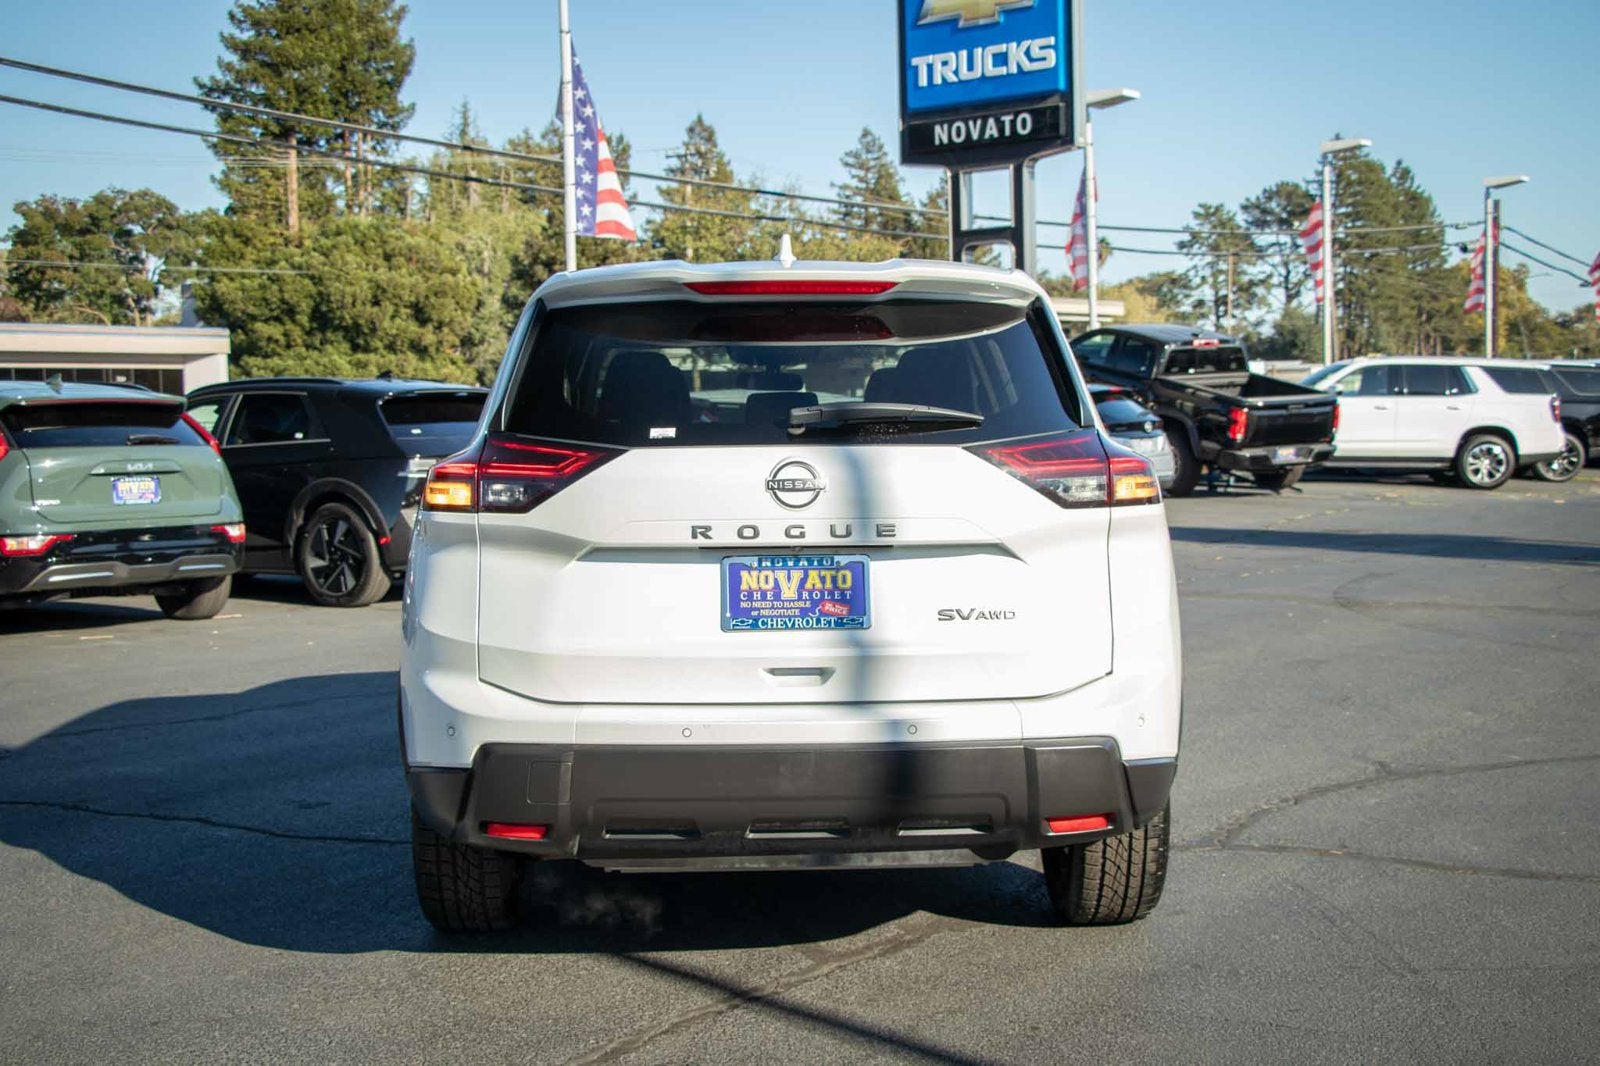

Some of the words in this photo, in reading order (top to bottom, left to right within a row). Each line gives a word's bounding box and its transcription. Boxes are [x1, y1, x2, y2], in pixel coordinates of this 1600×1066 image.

[911, 36, 1057, 87] TRUCKS
[934, 112, 1032, 146] NOVATO
[691, 523, 897, 540] ROGUE
[762, 557, 831, 567] NOVATO
[740, 570, 852, 599] NOVATO
[758, 617, 837, 628] CHEVROLET
[937, 608, 976, 621] SV
[975, 610, 1016, 621] AWD
